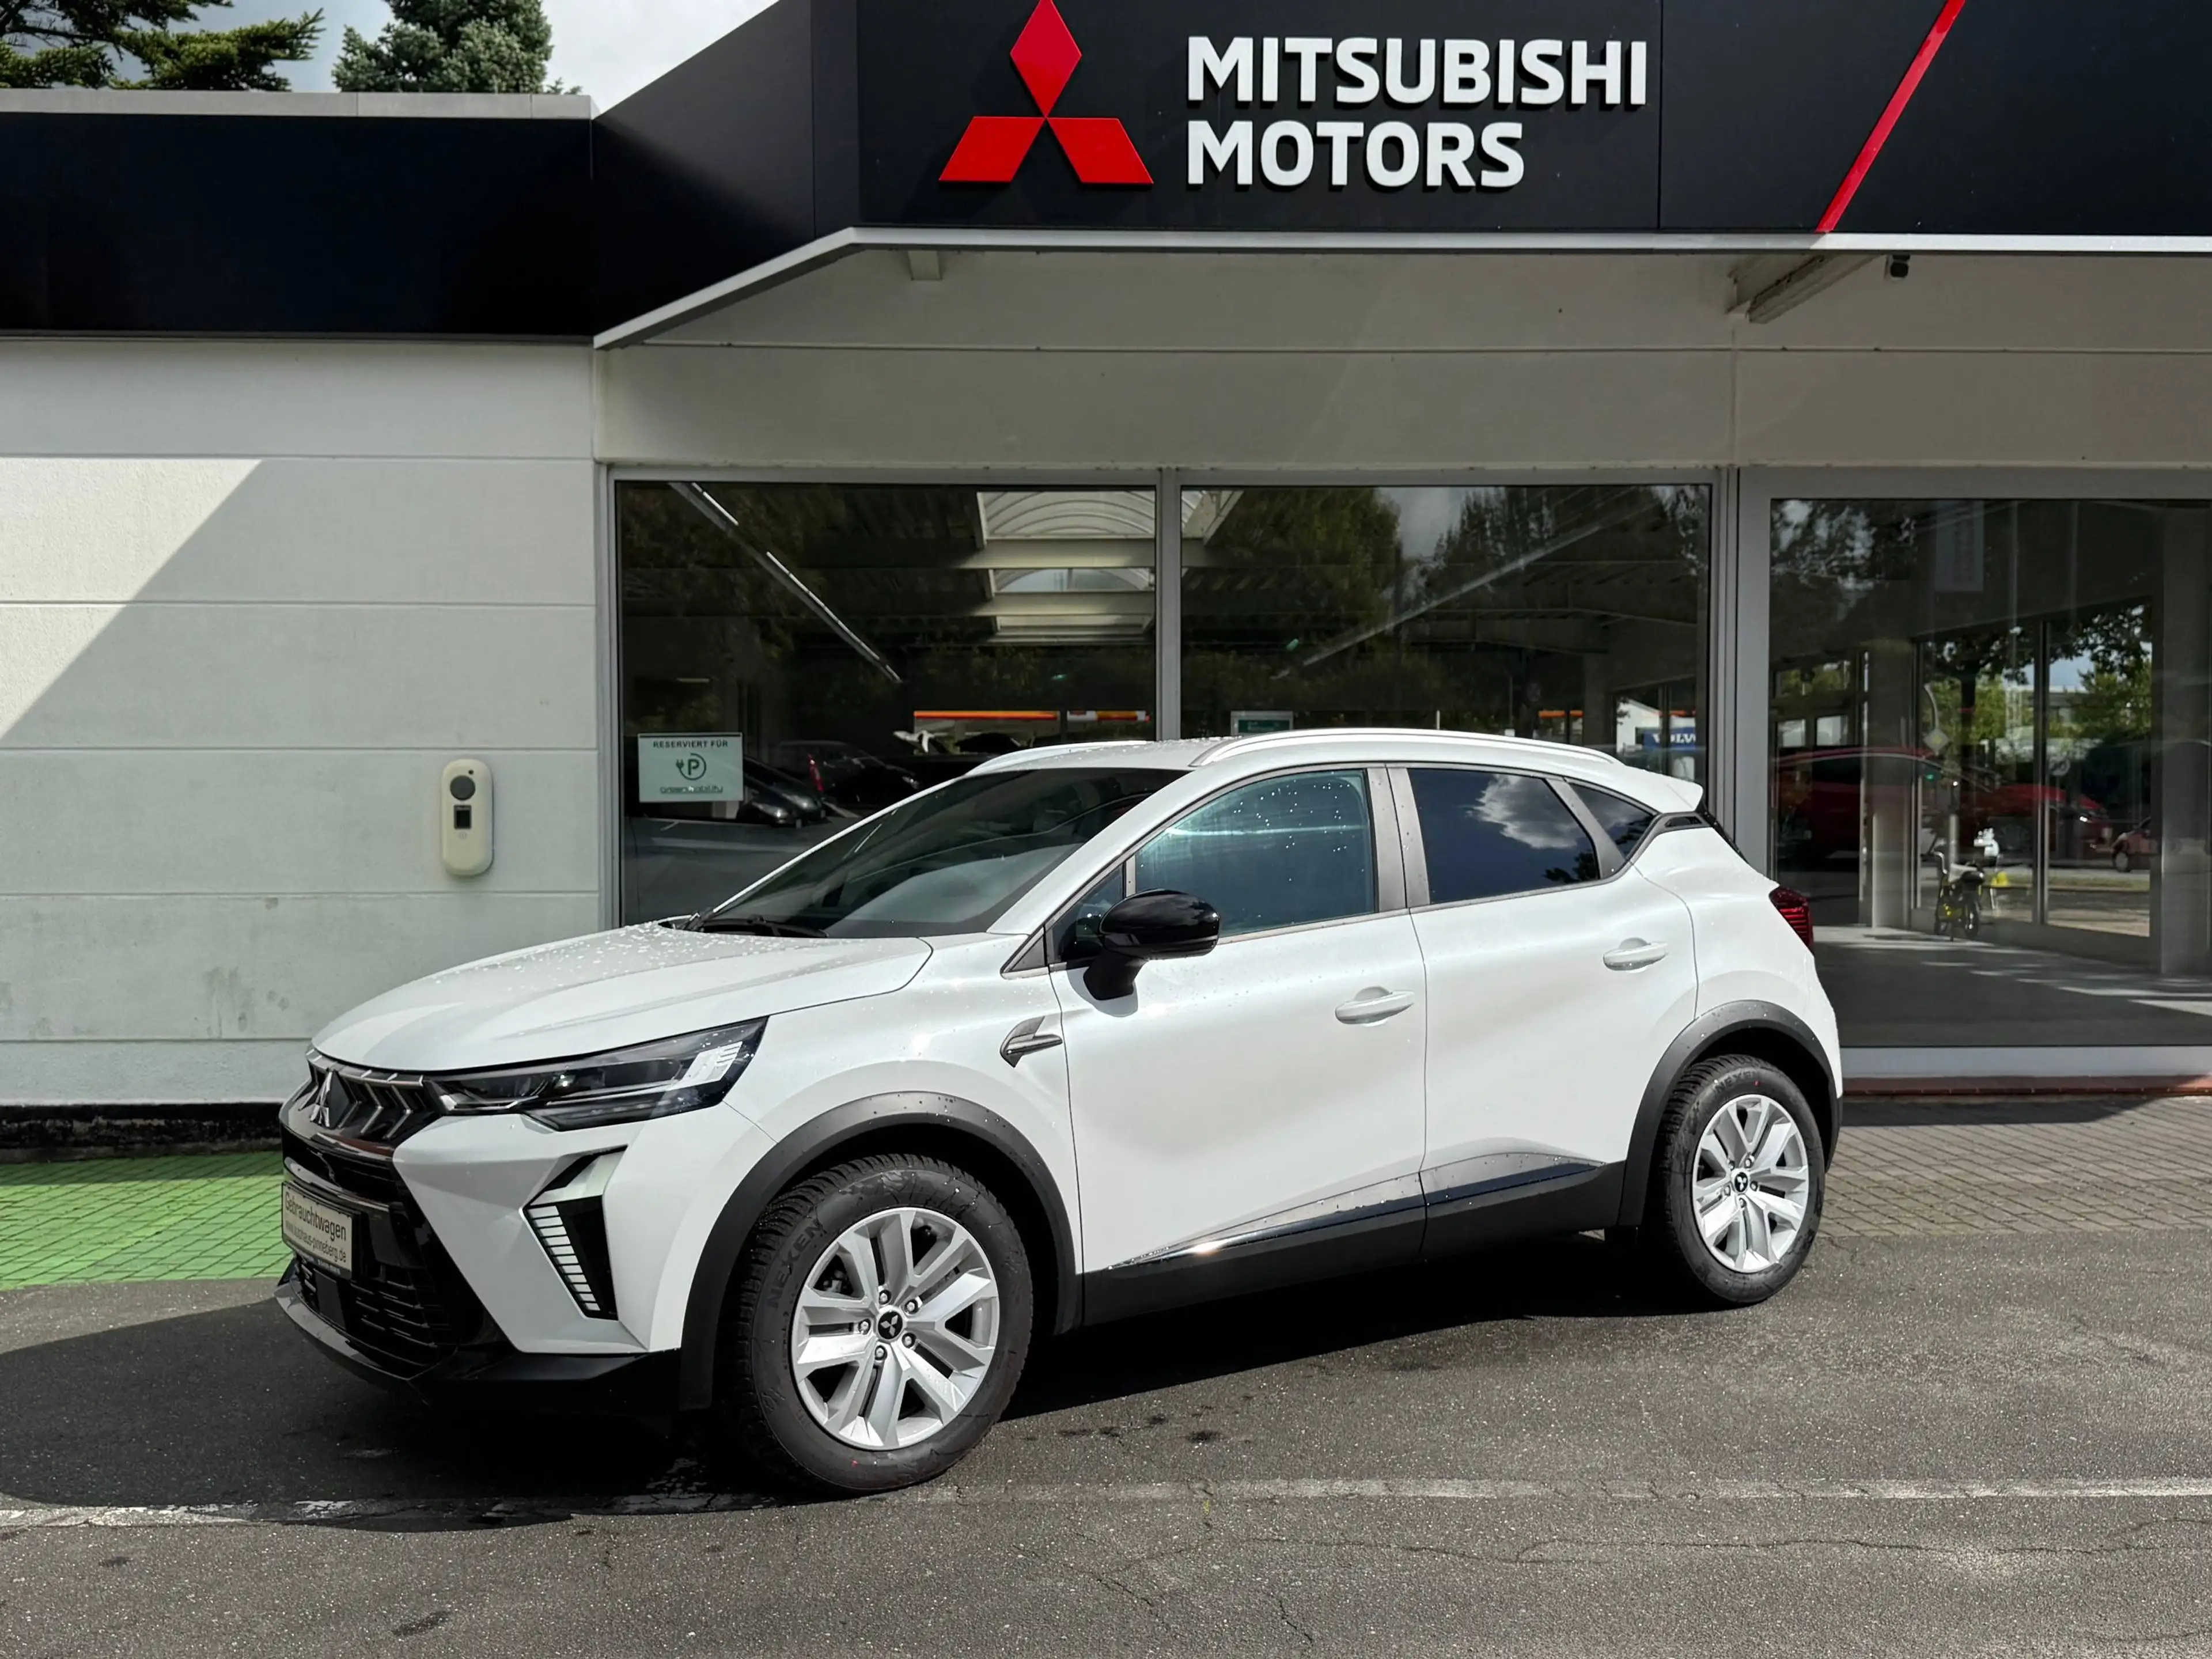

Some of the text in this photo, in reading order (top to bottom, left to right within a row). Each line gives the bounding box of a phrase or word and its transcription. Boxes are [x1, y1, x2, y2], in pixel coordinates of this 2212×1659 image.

[1188, 36, 1646, 104] MITSUBISHI
[1188, 120, 1525, 187] MOTORS
[653, 739, 728, 748] RESERVIERT FÜR
[285, 1191, 346, 1242] Gebrauchtwagen
[767, 1218, 823, 1309] NEXEN
